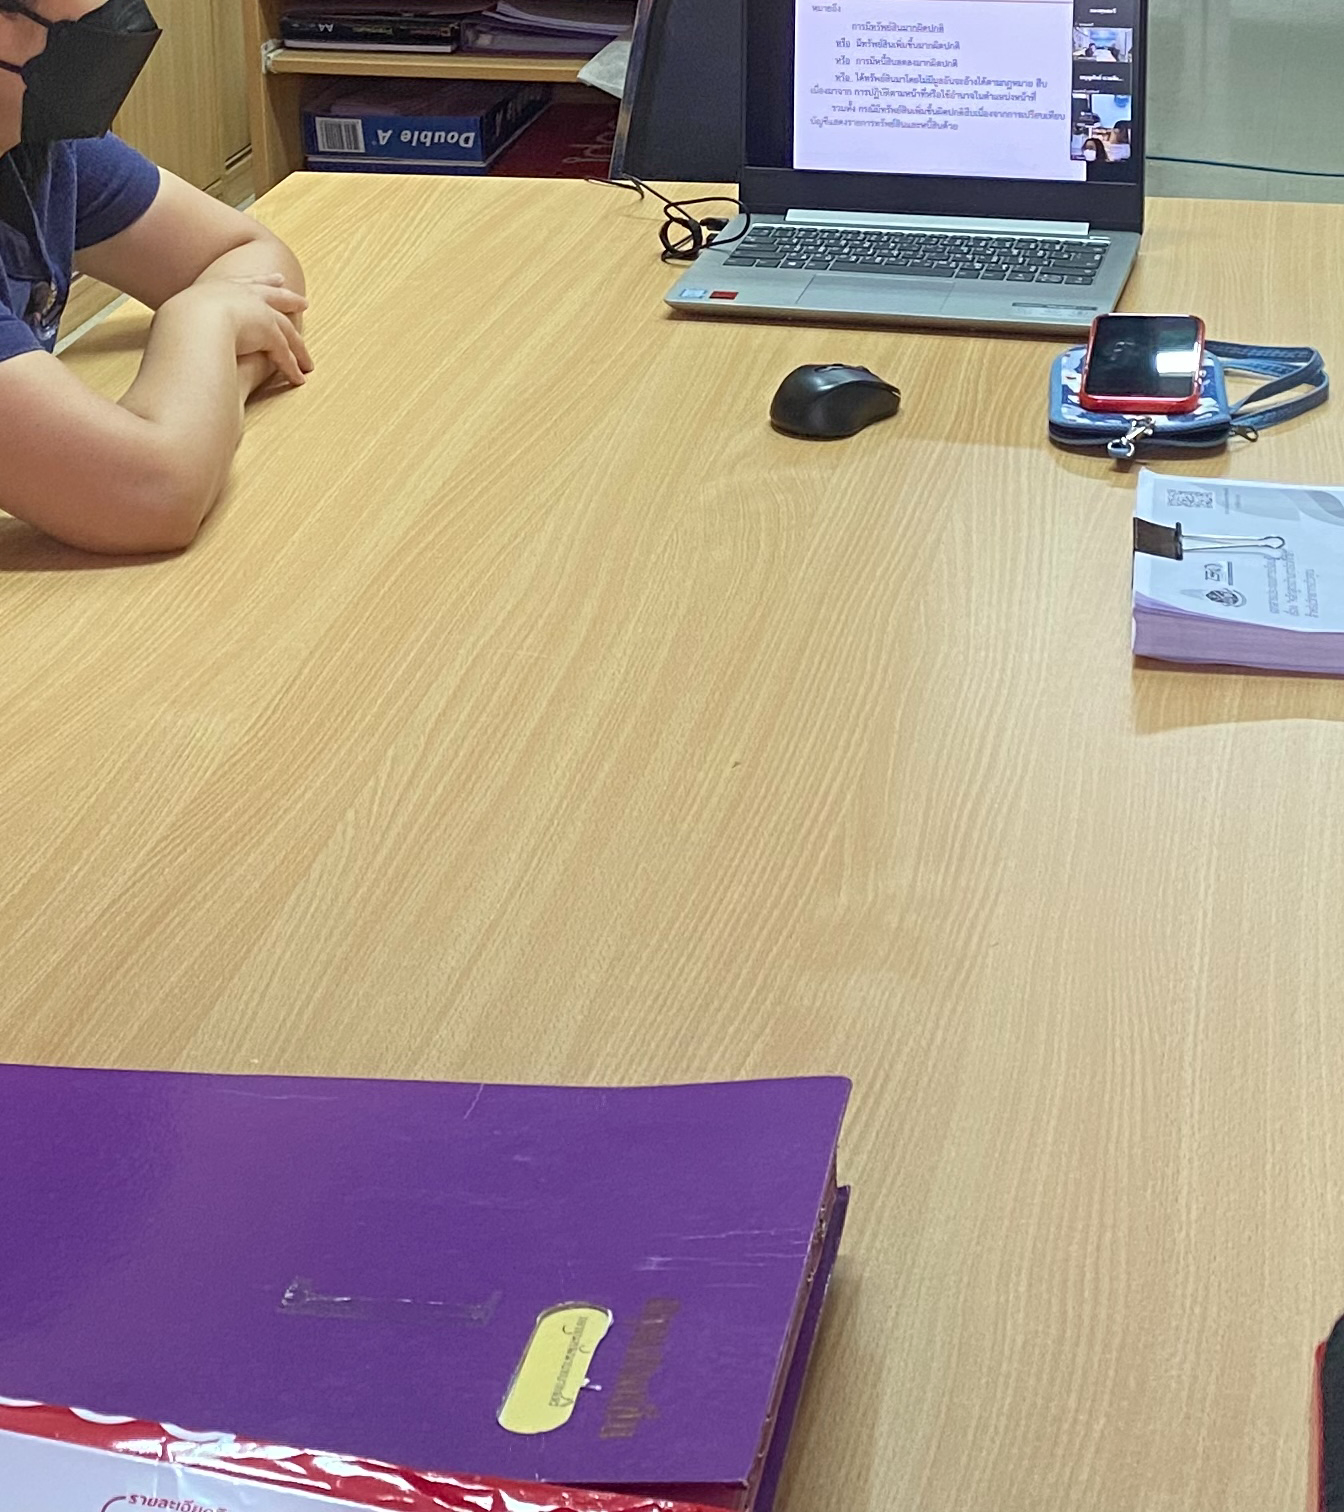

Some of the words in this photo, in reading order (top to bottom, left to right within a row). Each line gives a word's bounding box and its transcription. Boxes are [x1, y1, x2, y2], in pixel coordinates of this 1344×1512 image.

[317, 23, 334, 33] A4
[835, 37, 851, 48] หรือ
[376, 129, 393, 144] A
[400, 130, 476, 148] Double
